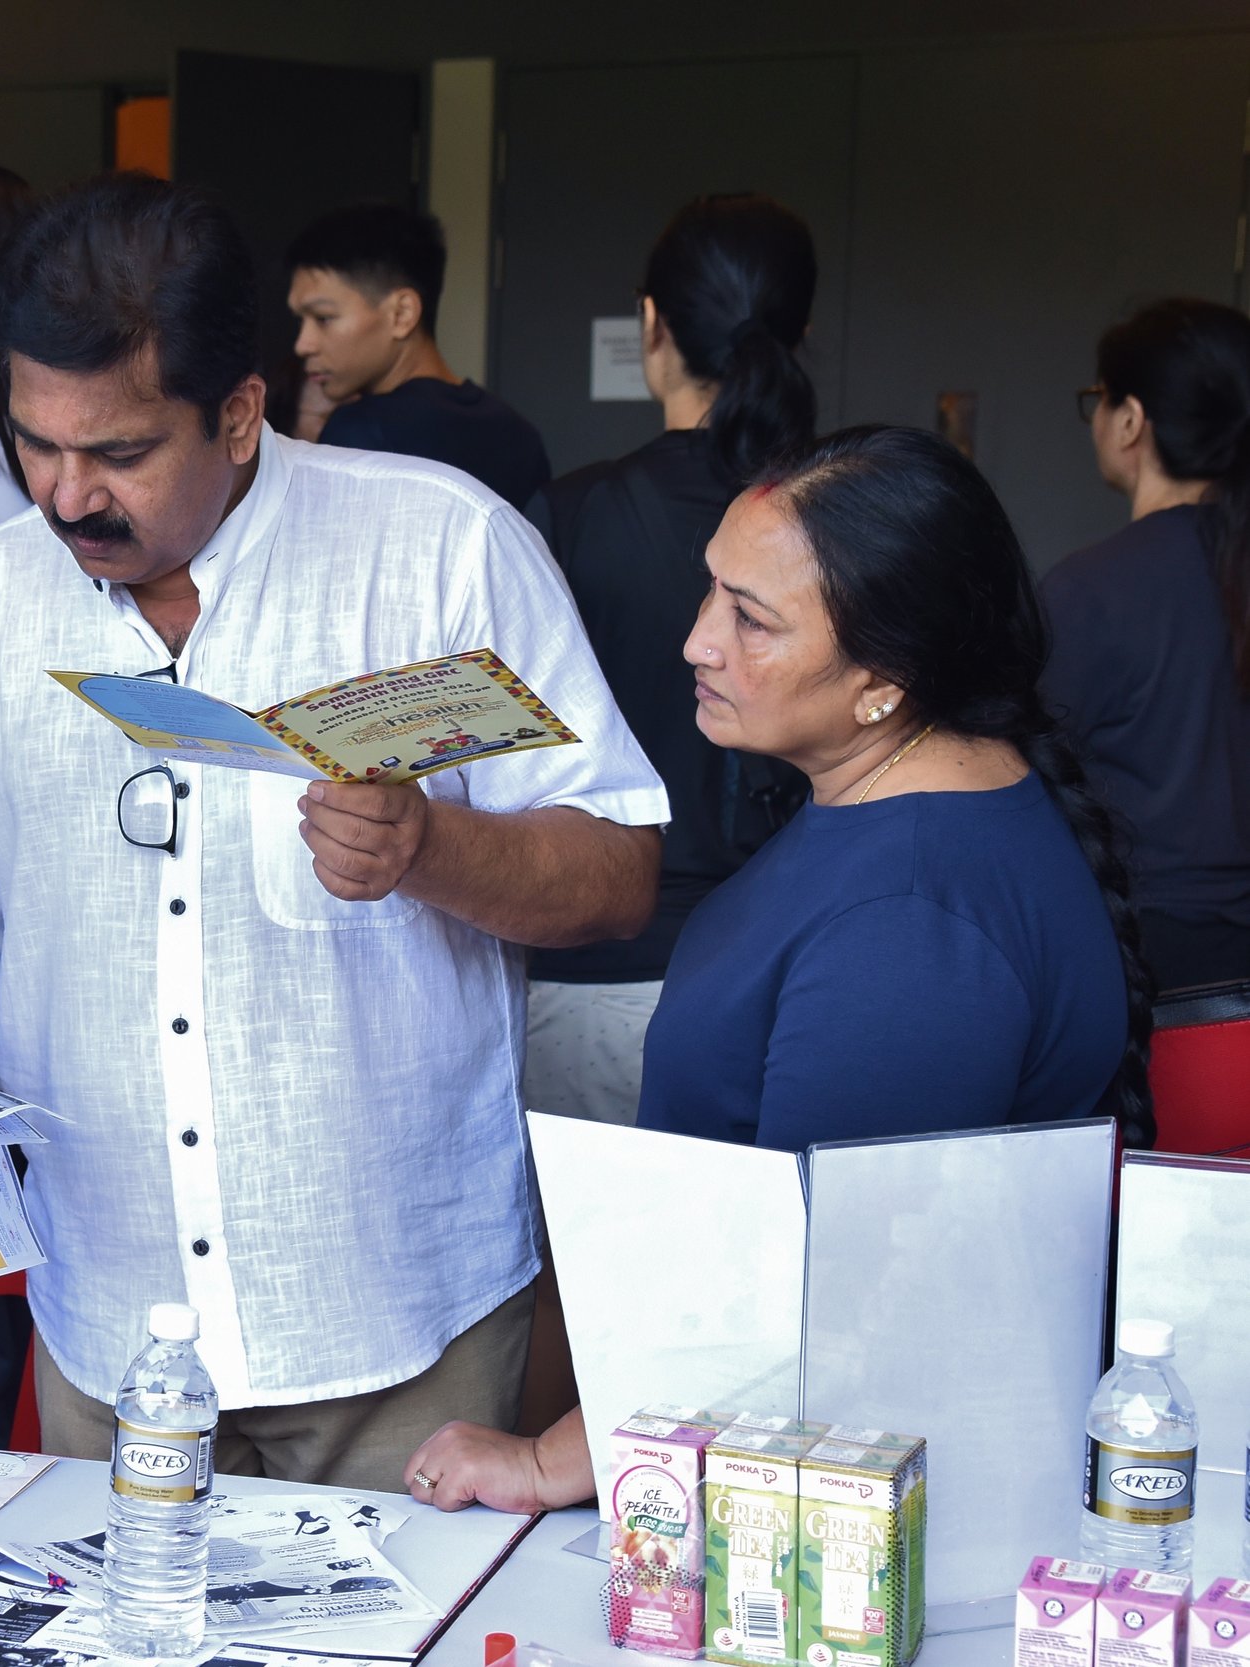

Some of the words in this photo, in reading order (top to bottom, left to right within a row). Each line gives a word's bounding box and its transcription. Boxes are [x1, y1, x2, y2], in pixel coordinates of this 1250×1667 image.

[306, 674, 420, 712] Sembawang
[423, 666, 462, 683] GRC
[333, 690, 391, 711] Health
[394, 677, 446, 698] Fiesta
[320, 704, 371, 726] Sunday,
[388, 688, 439, 703] October
[442, 682, 473, 692] 2024
[387, 700, 482, 728] health
[345, 706, 390, 725] Canberra
[123, 1449, 188, 1470] AREES
[634, 1448, 659, 1458] POKKA
[725, 1463, 760, 1475] POKKA
[819, 1477, 856, 1489] POKKA
[1113, 1473, 1184, 1493] AREES
[643, 1489, 662, 1501] ICE
[624, 1500, 661, 1516] PEACH
[663, 1507, 680, 1520] TEA
[712, 1496, 790, 1533] GREEN
[636, 1517, 657, 1529] LESS
[805, 1510, 885, 1548] GREEN
[729, 1528, 772, 1558] TEA
[822, 1542, 870, 1575] TEA
[299, 1600, 398, 1614] Screening
[323, 1603, 403, 1617] Community
[281, 1613, 325, 1622] Health
[828, 1630, 861, 1641] JASMINE
